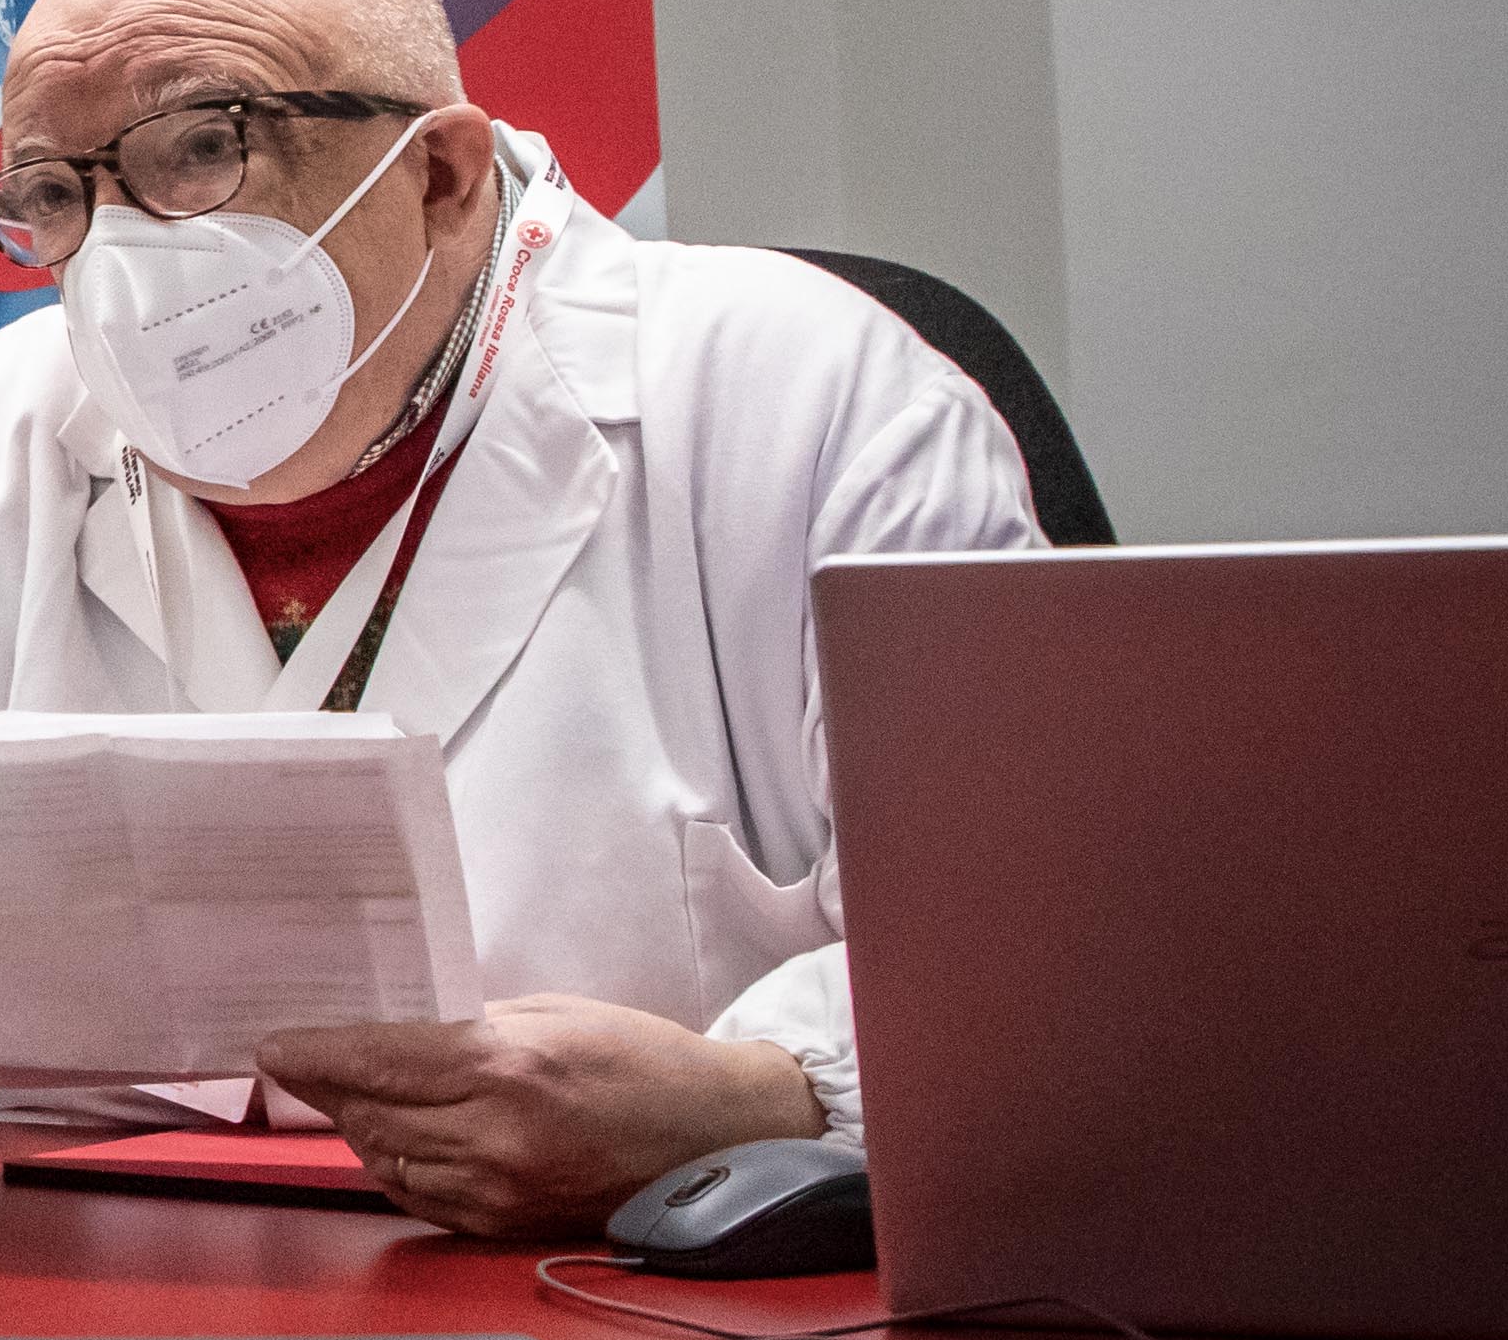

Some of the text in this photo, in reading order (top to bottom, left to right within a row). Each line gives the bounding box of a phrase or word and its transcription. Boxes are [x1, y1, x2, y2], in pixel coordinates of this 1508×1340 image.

[468, 249, 531, 399] Croce Rossa Italiana
